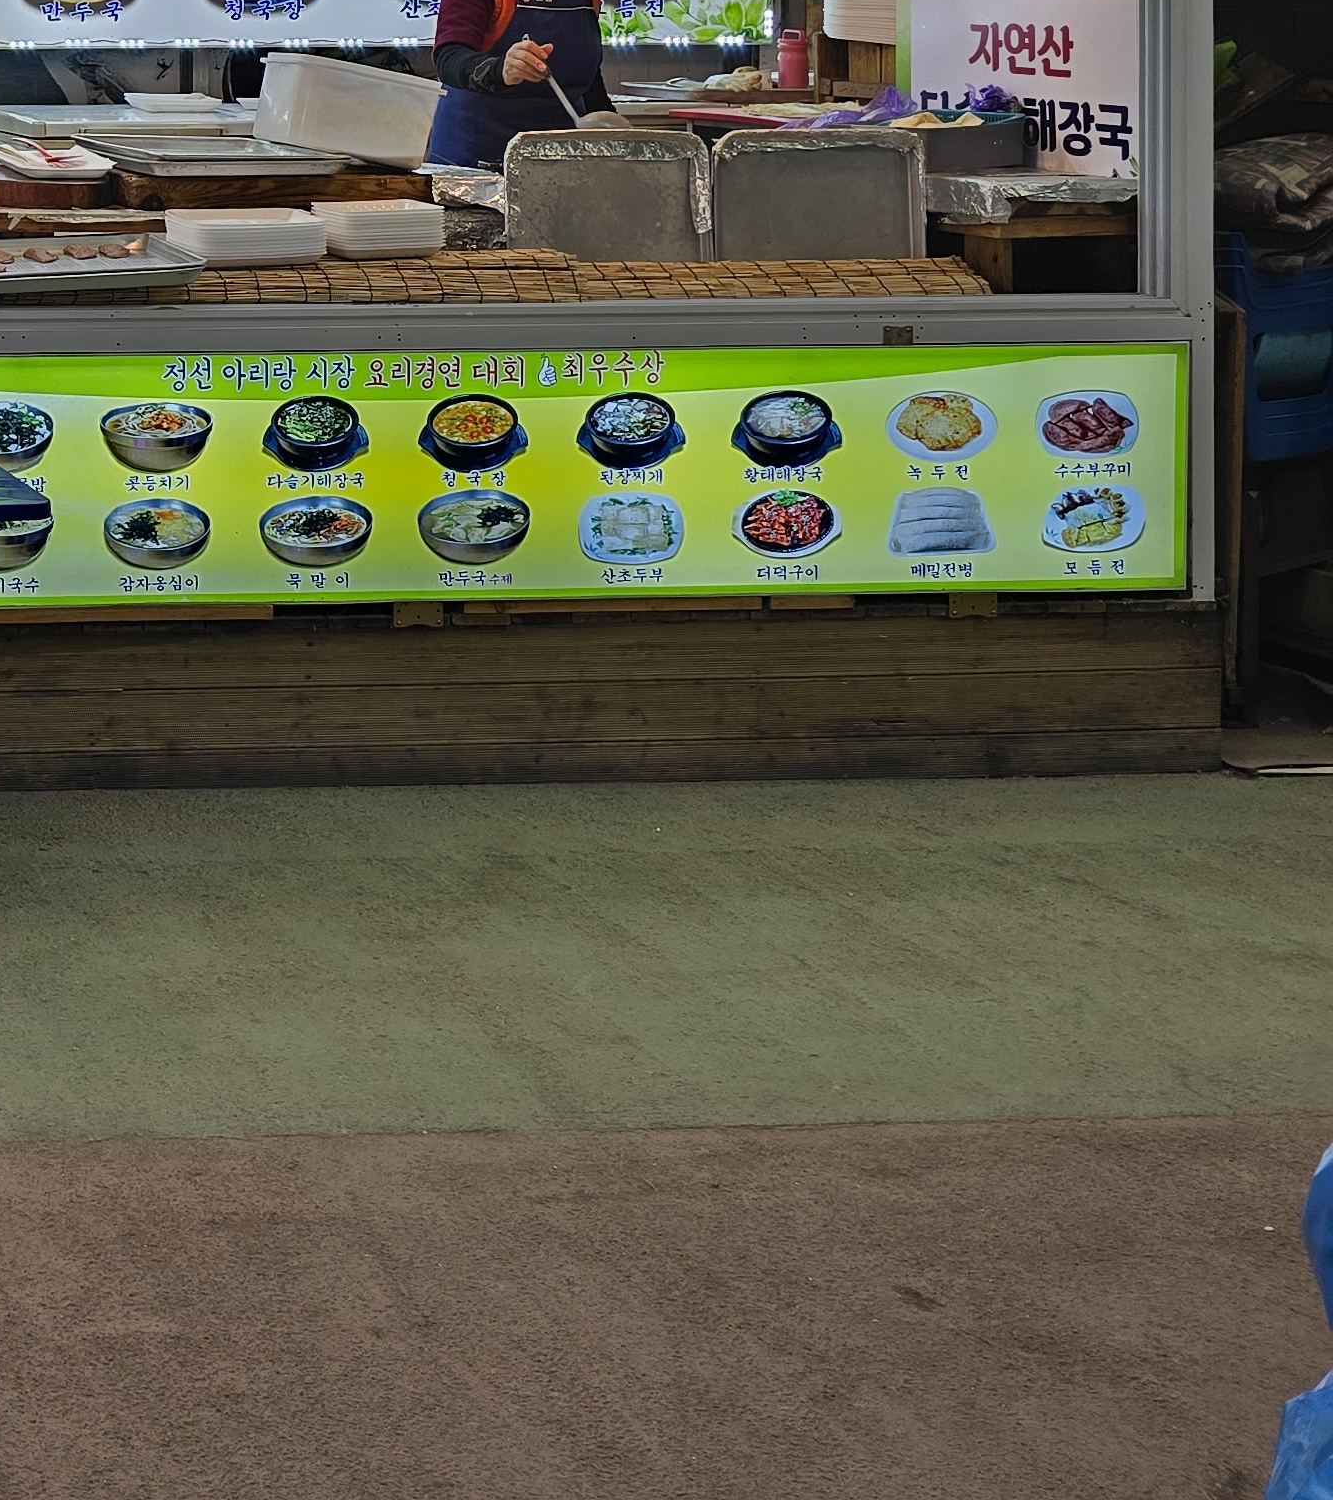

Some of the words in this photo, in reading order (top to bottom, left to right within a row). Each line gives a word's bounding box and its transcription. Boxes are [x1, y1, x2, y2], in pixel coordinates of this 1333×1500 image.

[40, 0, 125, 23] 만두국
[968, 21, 1075, 78] 자연산
[161, 357, 214, 393] 정선
[222, 357, 297, 392] 아리랑
[305, 355, 355, 391] 시장
[364, 355, 463, 389] 요리경연
[471, 354, 526, 388] 대회
[561, 349, 665, 386] 최우수상
[599, 468, 664, 487] 된장찌개
[743, 465, 824, 484] 황태해장국
[905, 463, 970, 482] 녹두전
[1053, 460, 1132, 479] 수수부꾸미
[124, 474, 191, 491] 콧등치기
[266, 470, 366, 490] 다슬기해장국
[441, 470, 507, 489] 청국장
[600, 567, 665, 586] 산초두부
[755, 563, 820, 582] 더덕구이
[910, 561, 974, 579] 메밀전병
[1063, 559, 1126, 577] 모듬전
[118, 571, 200, 592] 감자옹심이
[285, 571, 351, 590] 묵말이
[438, 570, 485, 588] 만두국
